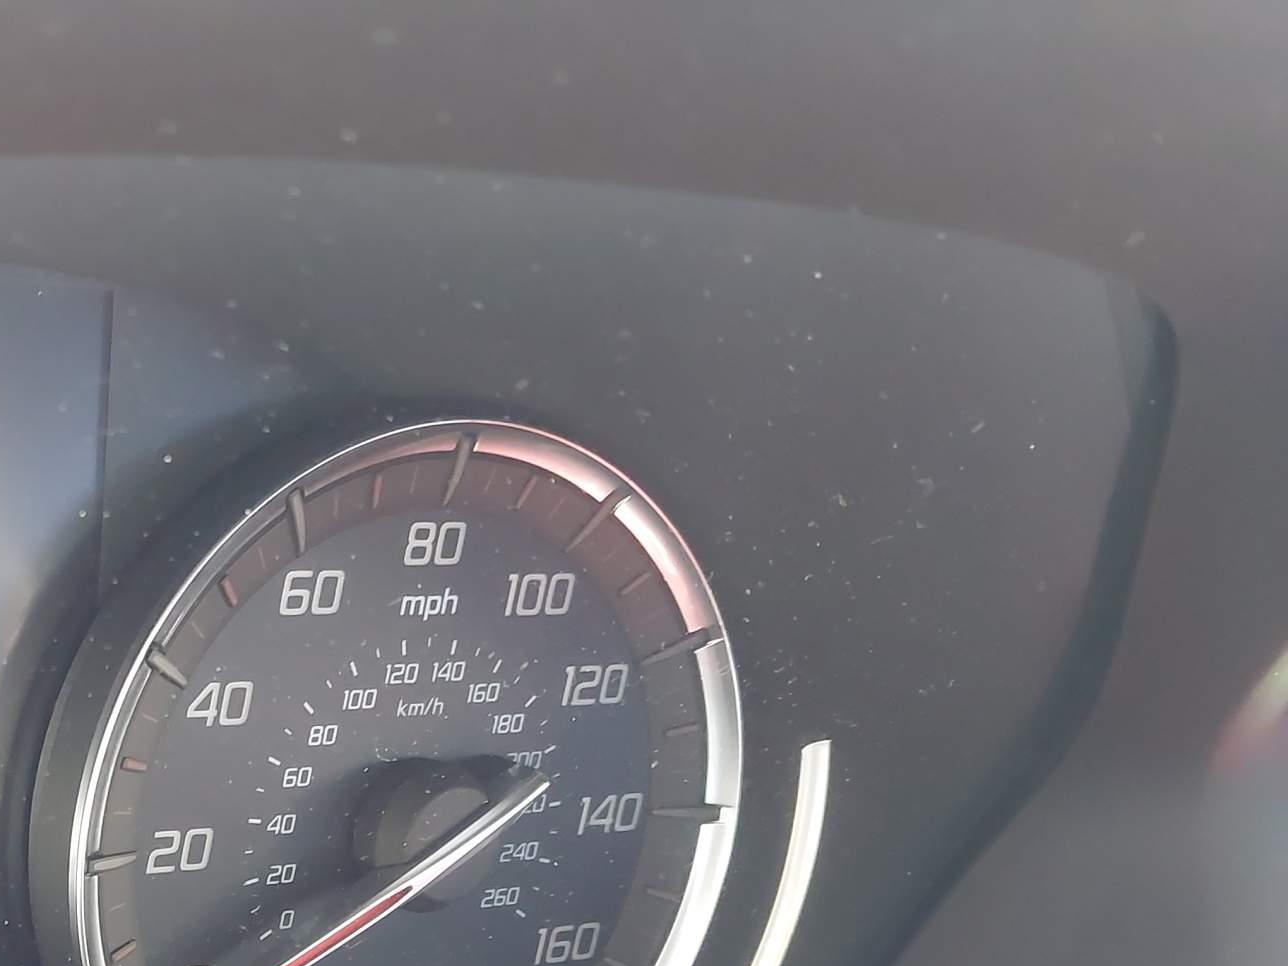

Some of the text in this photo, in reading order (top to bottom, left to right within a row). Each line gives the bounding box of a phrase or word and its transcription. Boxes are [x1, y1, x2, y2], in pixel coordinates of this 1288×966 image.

[403, 521, 467, 566] 80
[279, 569, 345, 616] 60
[503, 572, 575, 617] 100
[399, 590, 459, 618] mph
[384, 663, 419, 684] 120
[431, 661, 466, 682] 140
[467, 682, 501, 704] 160
[561, 664, 629, 707] 120
[186, 681, 254, 727] 40
[341, 688, 378, 710] 100
[396, 700, 445, 718] km/h
[492, 713, 525, 734] 180
[308, 724, 338, 746] 80
[282, 767, 313, 788] 60
[266, 814, 297, 835] 40
[577, 792, 643, 836] 140
[146, 827, 213, 874] 20
[499, 841, 539, 861] 240
[265, 864, 297, 885] 20
[480, 887, 521, 908] 260
[279, 909, 295, 931] 0
[534, 922, 601, 966] 160
